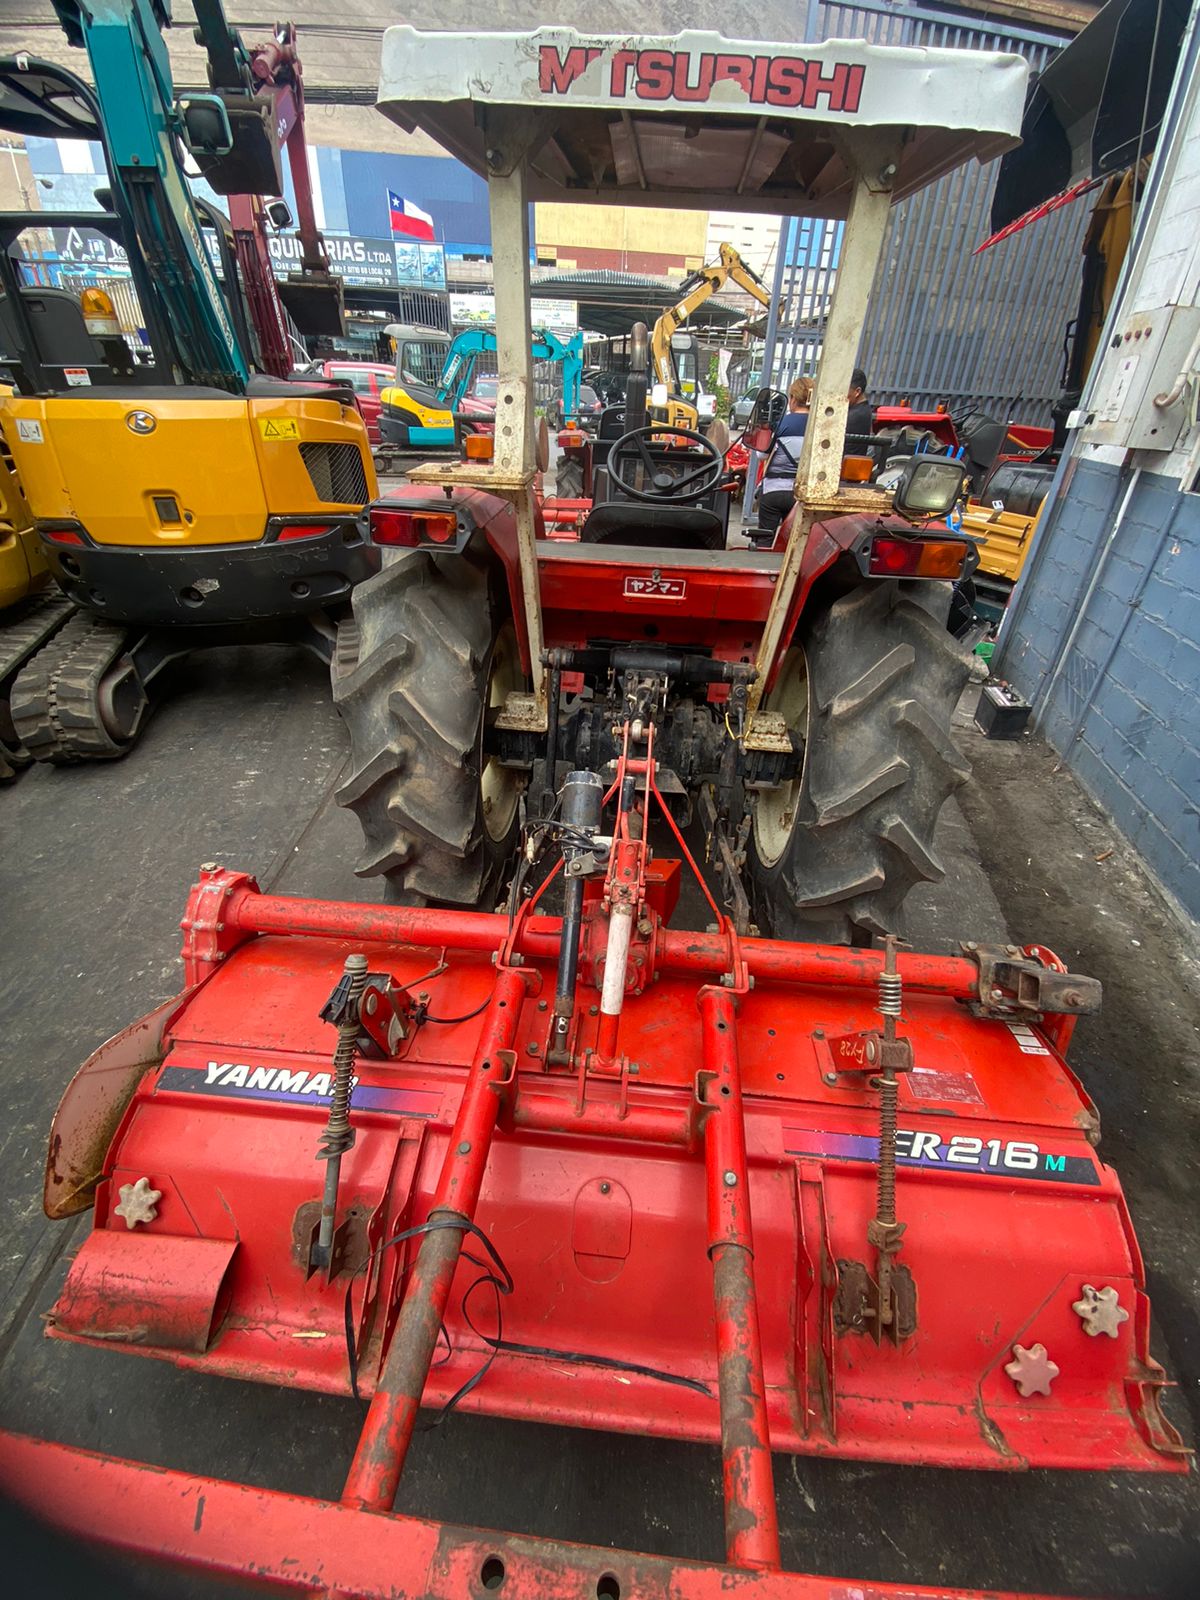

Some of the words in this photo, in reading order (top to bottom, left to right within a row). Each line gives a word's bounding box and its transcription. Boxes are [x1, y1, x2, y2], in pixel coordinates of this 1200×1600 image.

[538, 45, 867, 113] MTSUBISHI
[367, 251, 393, 264] LTDA
[368, 267, 384, 275] LOCAL
[630, 580, 680, 593] ヤンマー
[1045, 1154, 1067, 1173] M
